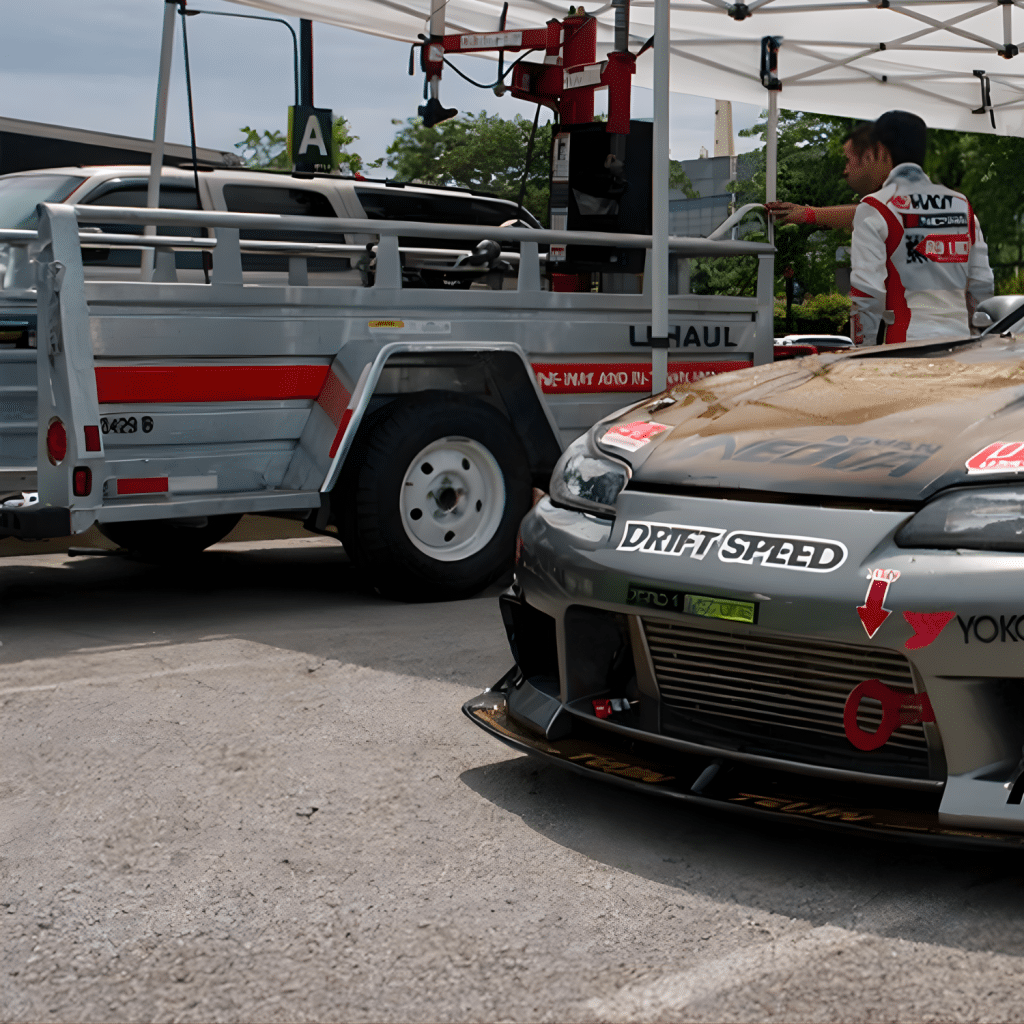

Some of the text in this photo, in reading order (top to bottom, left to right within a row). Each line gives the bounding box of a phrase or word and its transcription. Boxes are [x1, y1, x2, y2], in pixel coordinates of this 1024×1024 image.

[298, 114, 328, 156] A
[629, 325, 738, 348] UHAUL
[621, 523, 846, 571] DRIFT SPEED
